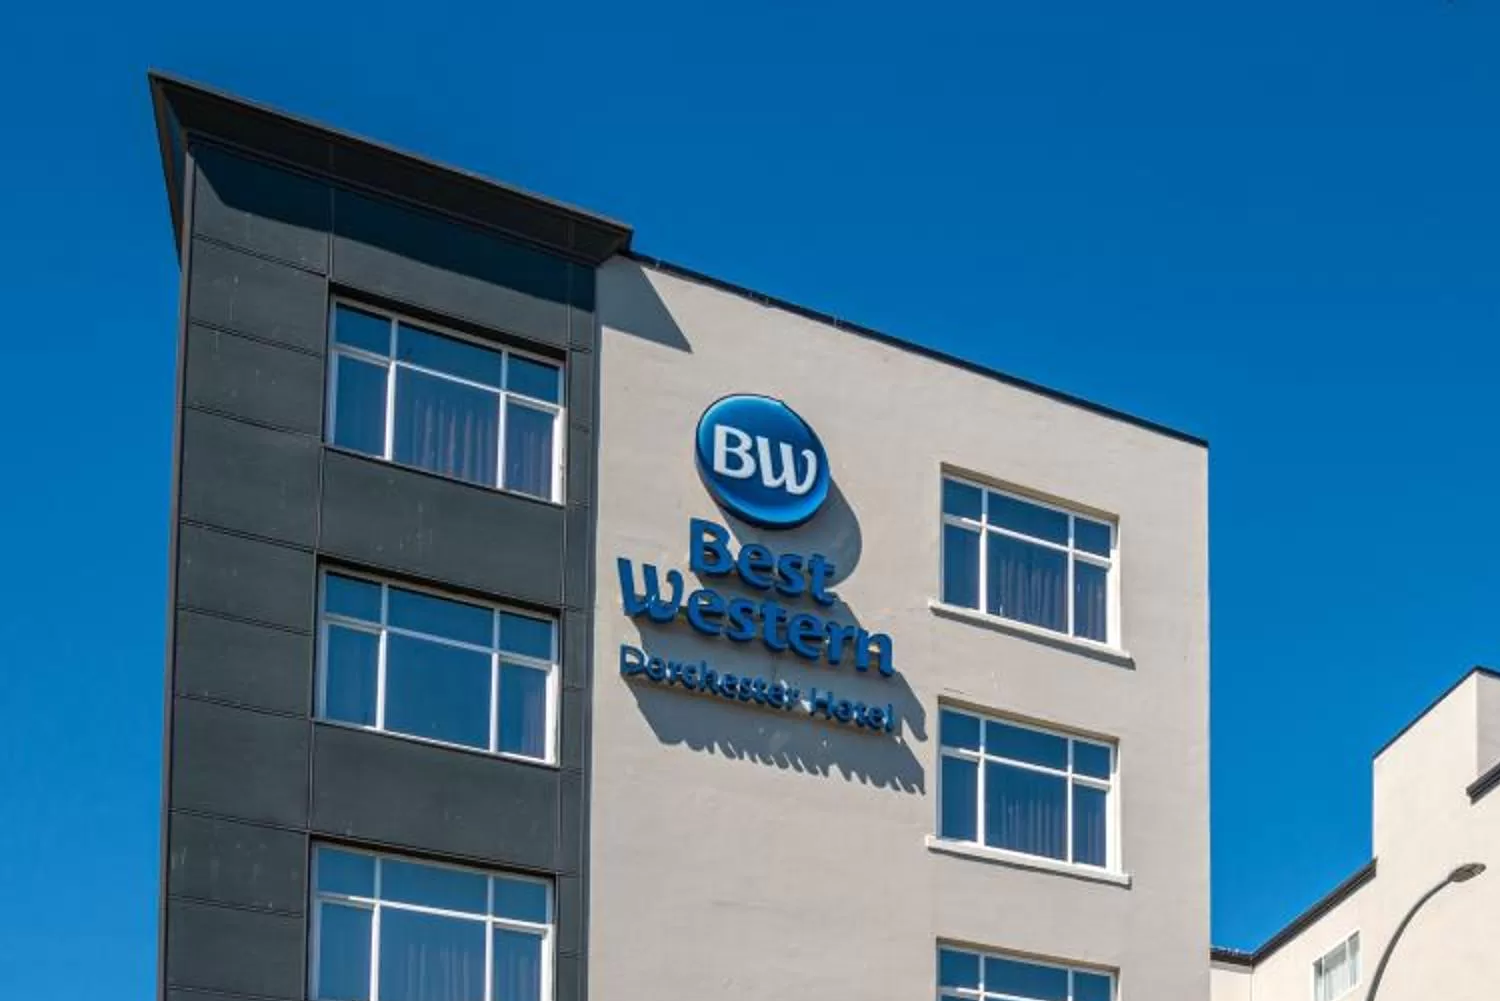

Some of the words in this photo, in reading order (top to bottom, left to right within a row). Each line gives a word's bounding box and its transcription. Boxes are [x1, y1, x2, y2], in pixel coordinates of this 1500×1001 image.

[713, 424, 818, 496] BW
[689, 517, 837, 606] Best
[616, 557, 896, 678] Western
[619, 644, 799, 710] Dorchester
[809, 687, 895, 733] Hotel
